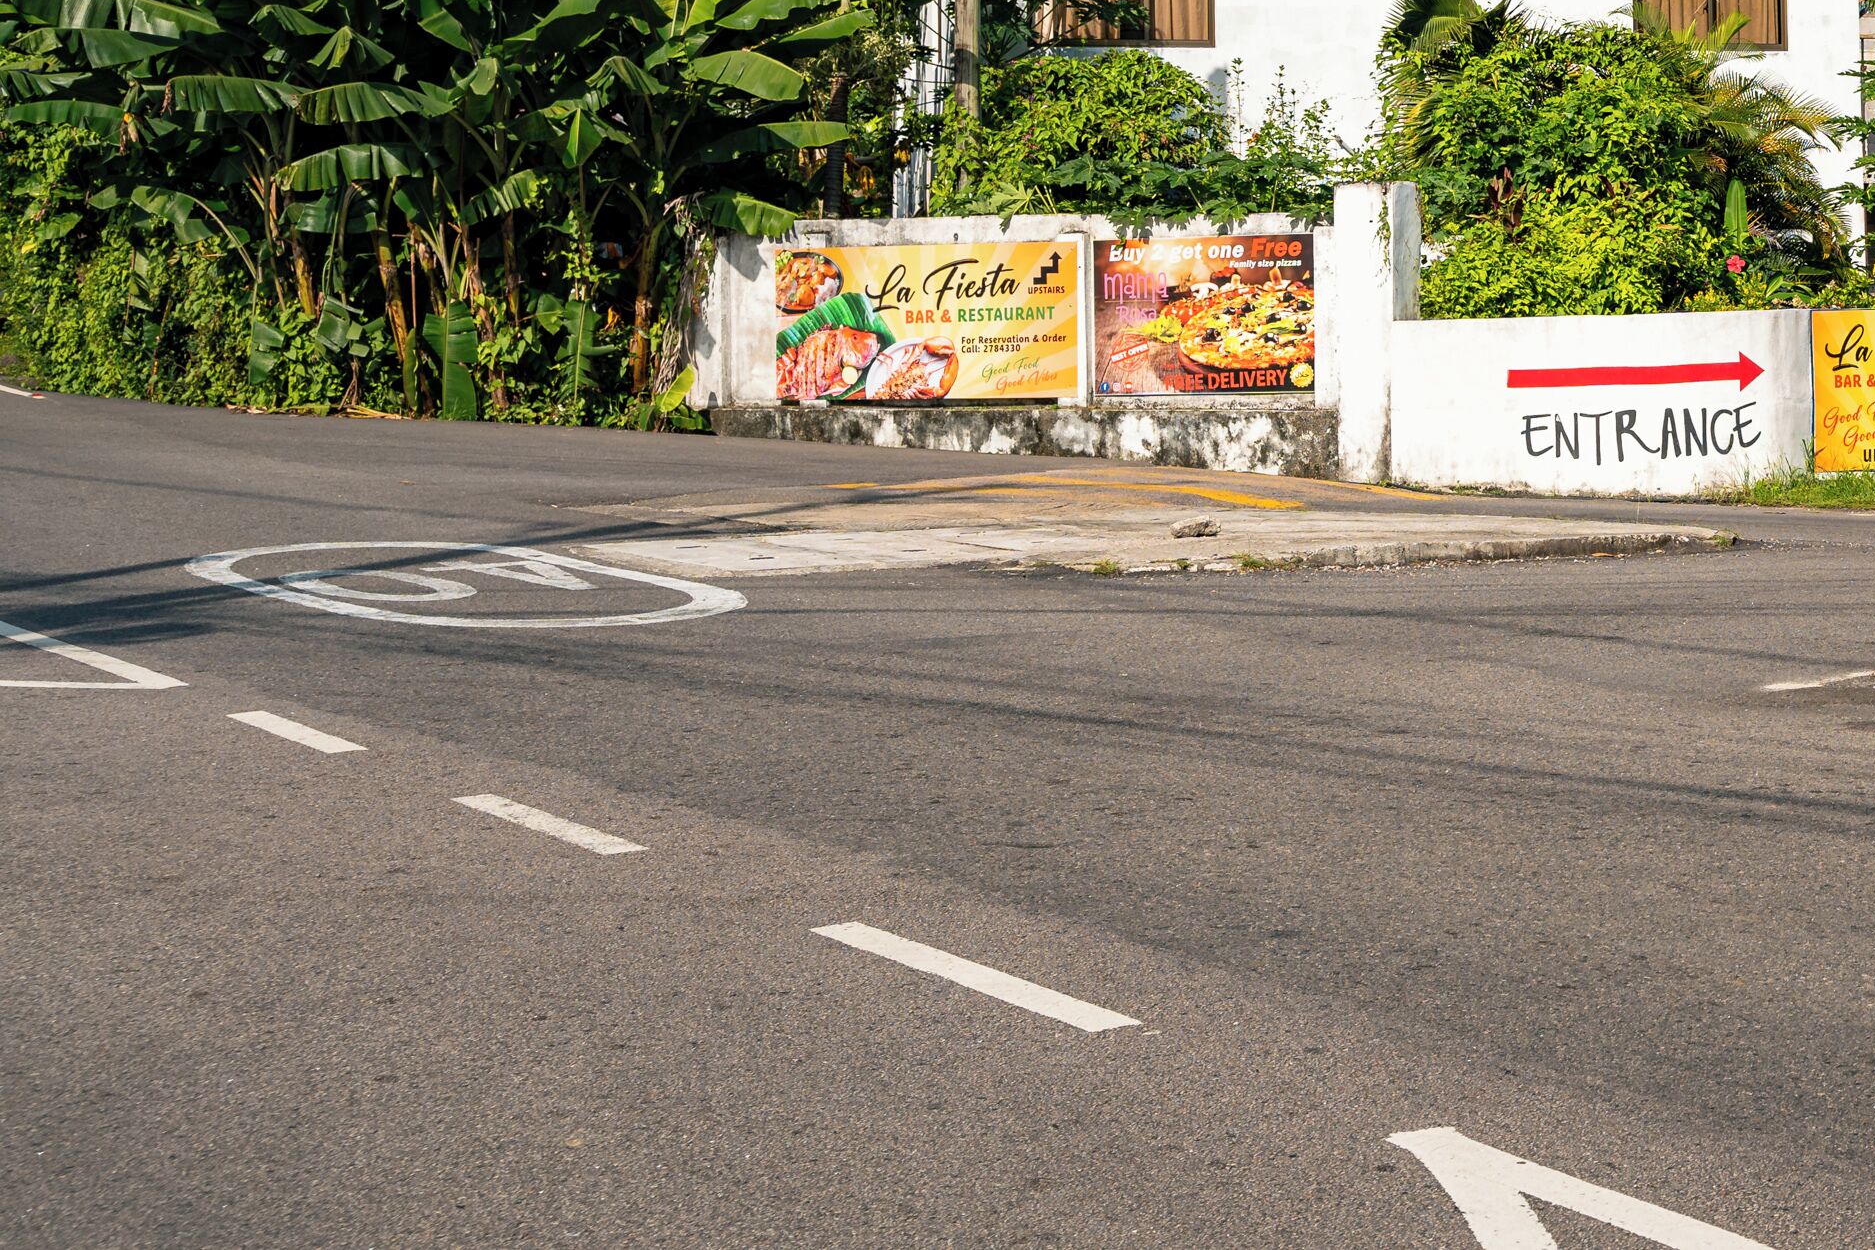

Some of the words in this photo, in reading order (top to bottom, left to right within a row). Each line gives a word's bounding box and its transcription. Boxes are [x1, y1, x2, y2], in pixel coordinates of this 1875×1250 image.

[1109, 244, 1146, 265] Buy
[1150, 244, 1164, 261] 2
[1168, 242, 1203, 263] get
[1208, 244, 1244, 259] one
[1251, 238, 1302, 258] Free
[1229, 261, 1256, 269] Family
[1257, 260, 1273, 268] size
[1275, 259, 1302, 268] pizzas
[865, 264, 915, 313] La
[923, 258, 1020, 311] Fiesta
[1028, 285, 1066, 295] UPSTAIRS
[906, 309, 935, 324] BAR
[941, 309, 951, 323] &
[958, 306, 1055, 322] RESTAURANT
[961, 336, 976, 345] For
[979, 335, 1030, 345] Reservation
[1032, 334, 1040, 343] &
[1041, 333, 1067, 343] Order
[961, 344, 981, 354] Call:
[983, 344, 1021, 354] 2784330
[1825, 323, 1873, 371] La
[1111, 351, 1127, 363] BEST
[1128, 343, 1148, 356] OFFER
[981, 362, 1010, 383] Good
[1014, 356, 1040, 374] Food
[996, 375, 1025, 395] Good
[1027, 369, 1057, 385] Vibes
[1164, 374, 1204, 391] FREE
[1208, 370, 1287, 389] DELIVERY
[1834, 375, 1862, 388] BAR
[1823, 405, 1863, 436] Good
[1520, 401, 1762, 466] ENTRANCE
